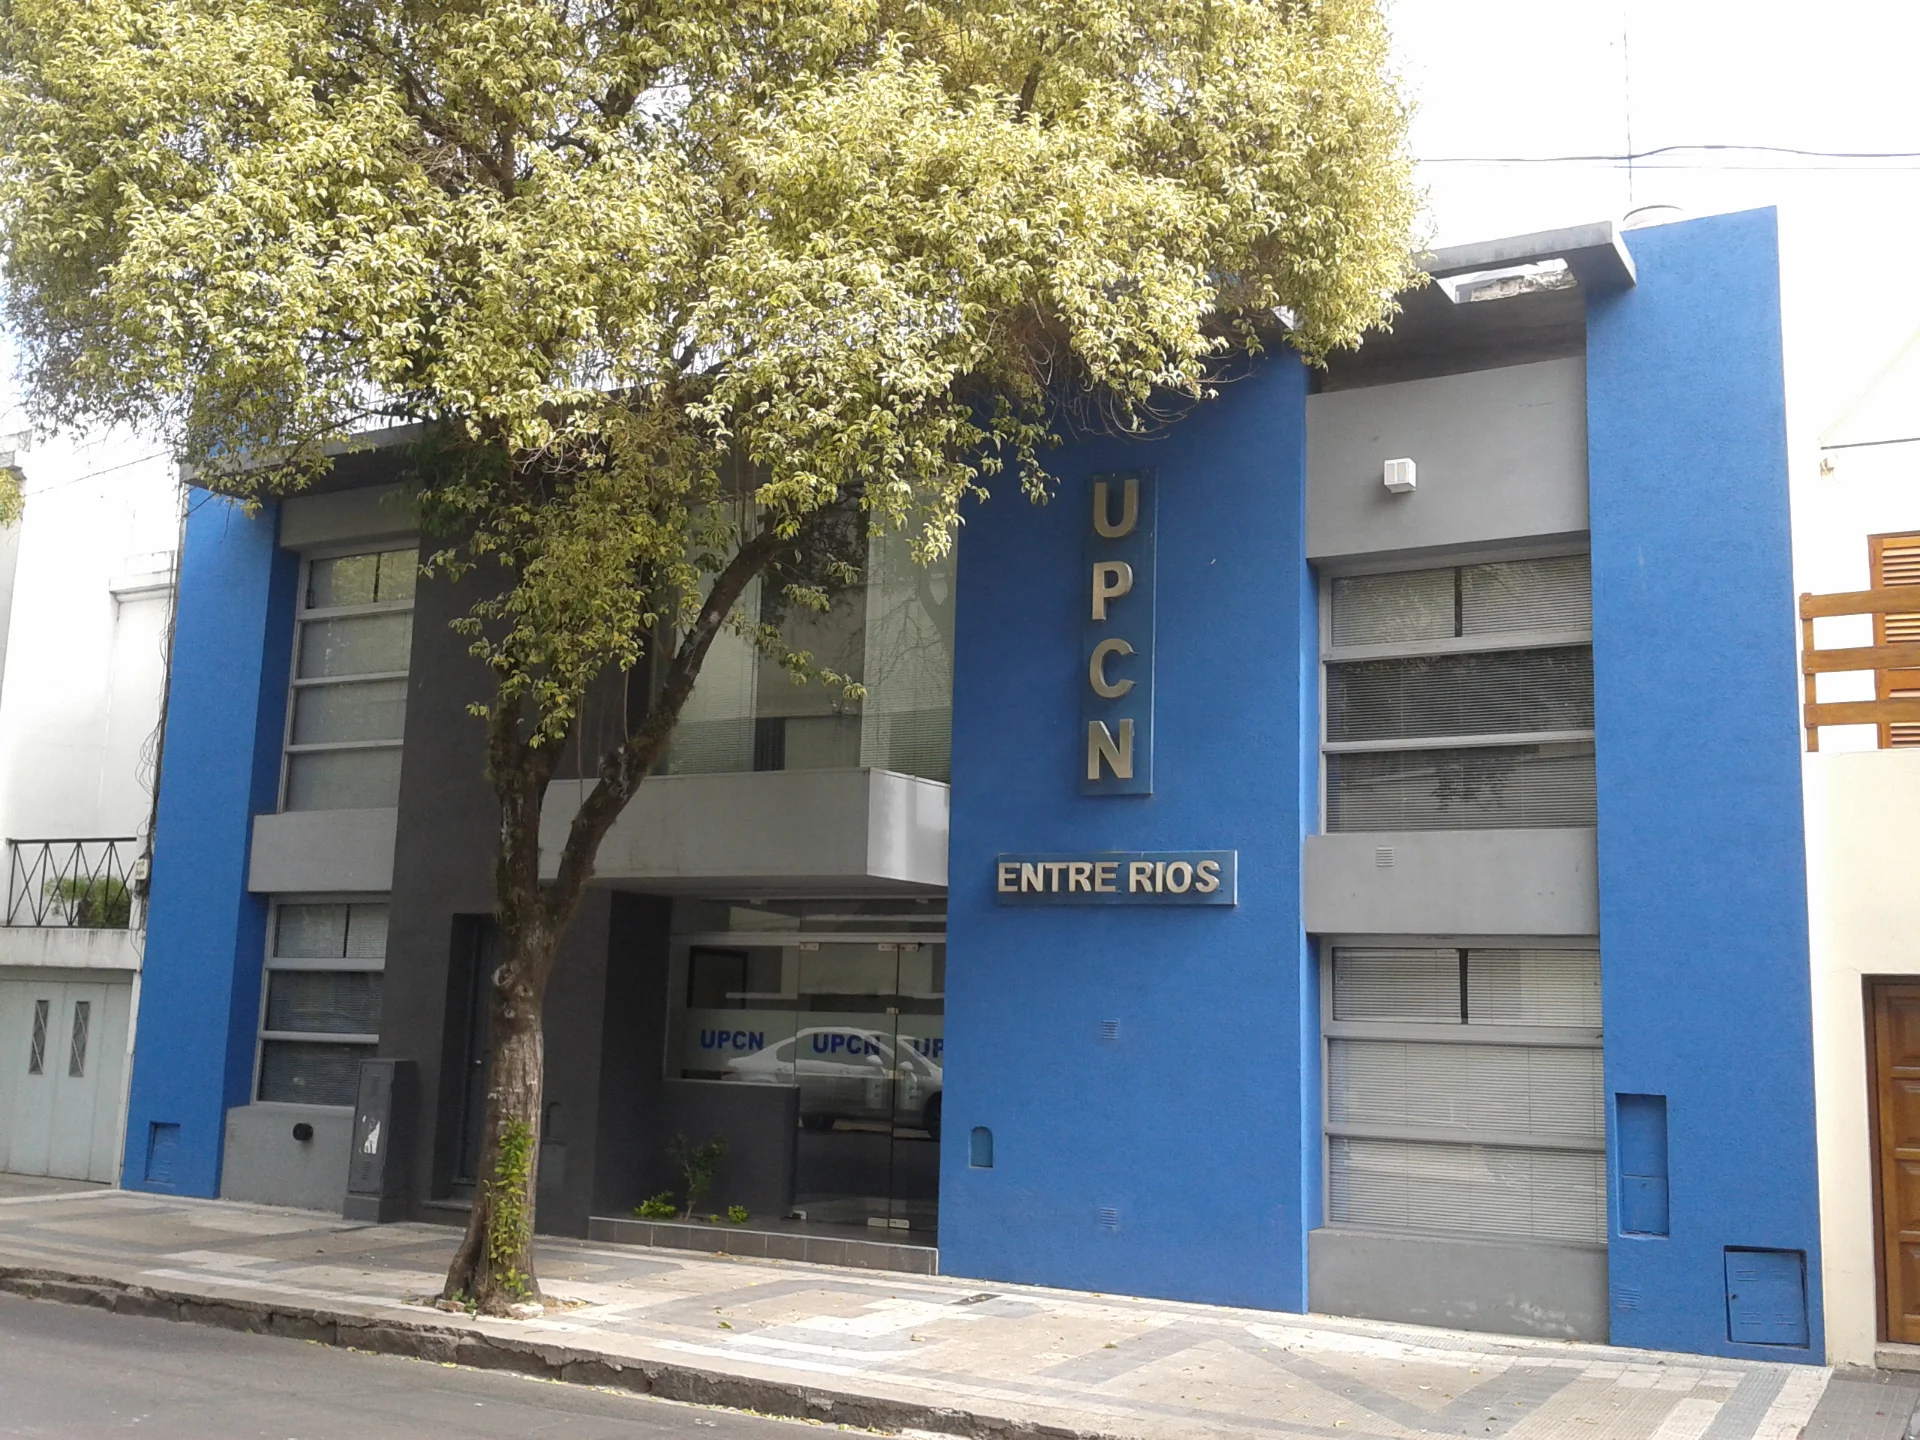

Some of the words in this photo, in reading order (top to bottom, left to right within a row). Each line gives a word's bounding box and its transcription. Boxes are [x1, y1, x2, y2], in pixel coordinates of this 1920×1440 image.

[1087, 479, 1139, 779] UPCN
[998, 861, 1118, 893] ENTRE
[1129, 860, 1221, 893] RIOS
[700, 1030, 764, 1051] UPCN
[813, 1034, 880, 1056] UPCN
